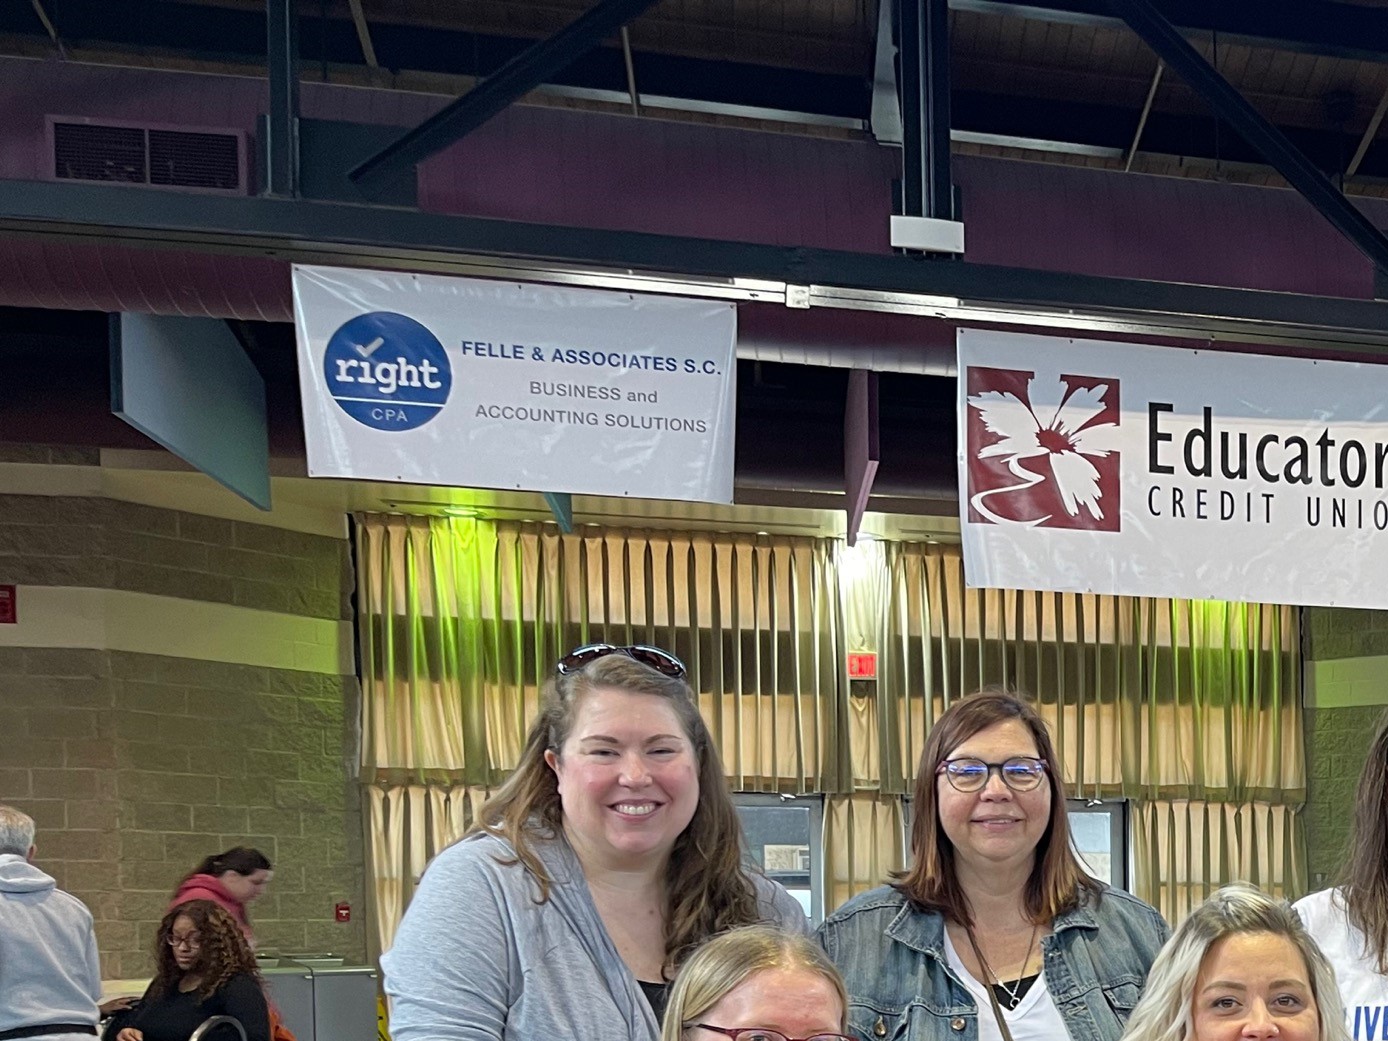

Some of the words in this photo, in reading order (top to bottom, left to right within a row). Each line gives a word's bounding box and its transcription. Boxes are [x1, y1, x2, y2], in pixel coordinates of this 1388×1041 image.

[336, 354, 442, 394] right
[461, 340, 525, 361] FELLE
[532, 346, 545, 363] &
[551, 348, 677, 373] ASSOCIATES
[684, 358, 722, 376] S.C.
[529, 380, 621, 403] BUSINESS
[627, 388, 658, 404] and
[371, 407, 408, 424] CPA
[475, 404, 599, 427] ACCOUNTING
[604, 412, 707, 433] SOLUTIONS
[1148, 485, 1276, 524] CREDIT
